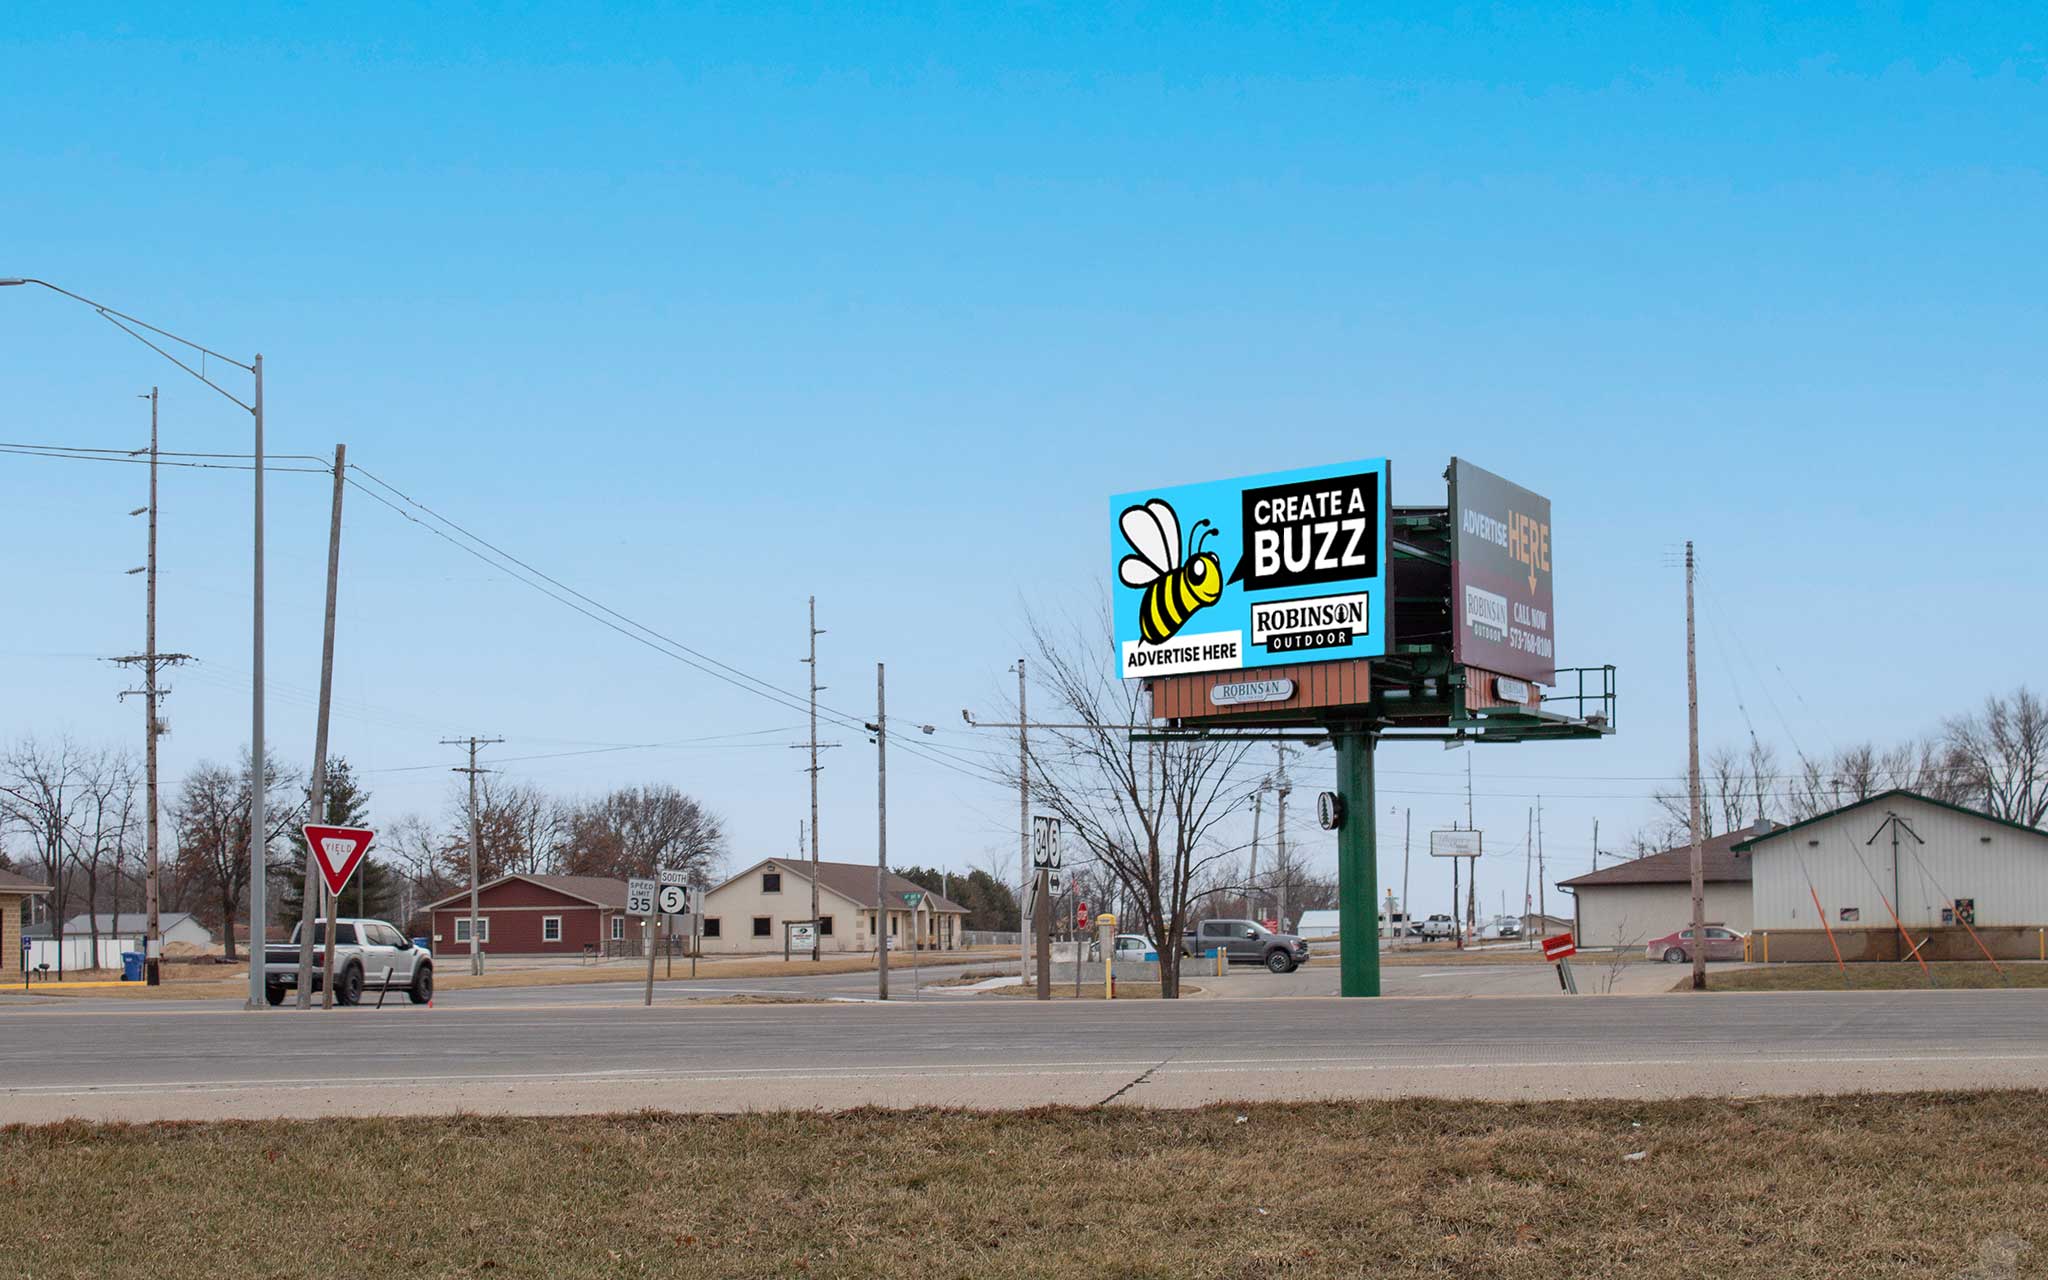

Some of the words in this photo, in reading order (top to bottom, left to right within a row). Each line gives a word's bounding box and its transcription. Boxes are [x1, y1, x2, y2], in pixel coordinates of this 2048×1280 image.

[1254, 489, 1342, 525] CREATE
[1347, 487, 1365, 514] A
[1254, 517, 1366, 577] BUZZ
[1463, 508, 1508, 548] ADVERTISE
[1508, 509, 1550, 572] HERE
[1257, 601, 1363, 632] ROBINSON
[1513, 602, 1531, 626] CALL
[1531, 607, 1548, 631] NOW
[1273, 631, 1346, 649] OUTDOOR
[1128, 646, 1200, 668] ADVERTISE
[1203, 642, 1237, 661] HERE
[1223, 681, 1280, 697] ROBINSON
[326, 842, 352, 853] YIELD
[1035, 828, 1046, 855] 34
[1052, 829, 1058, 856] 5
[630, 881, 654, 890] SPEED
[662, 872, 687, 882] SOUTH
[629, 897, 651, 912] 35
[666, 891, 677, 908] 5
